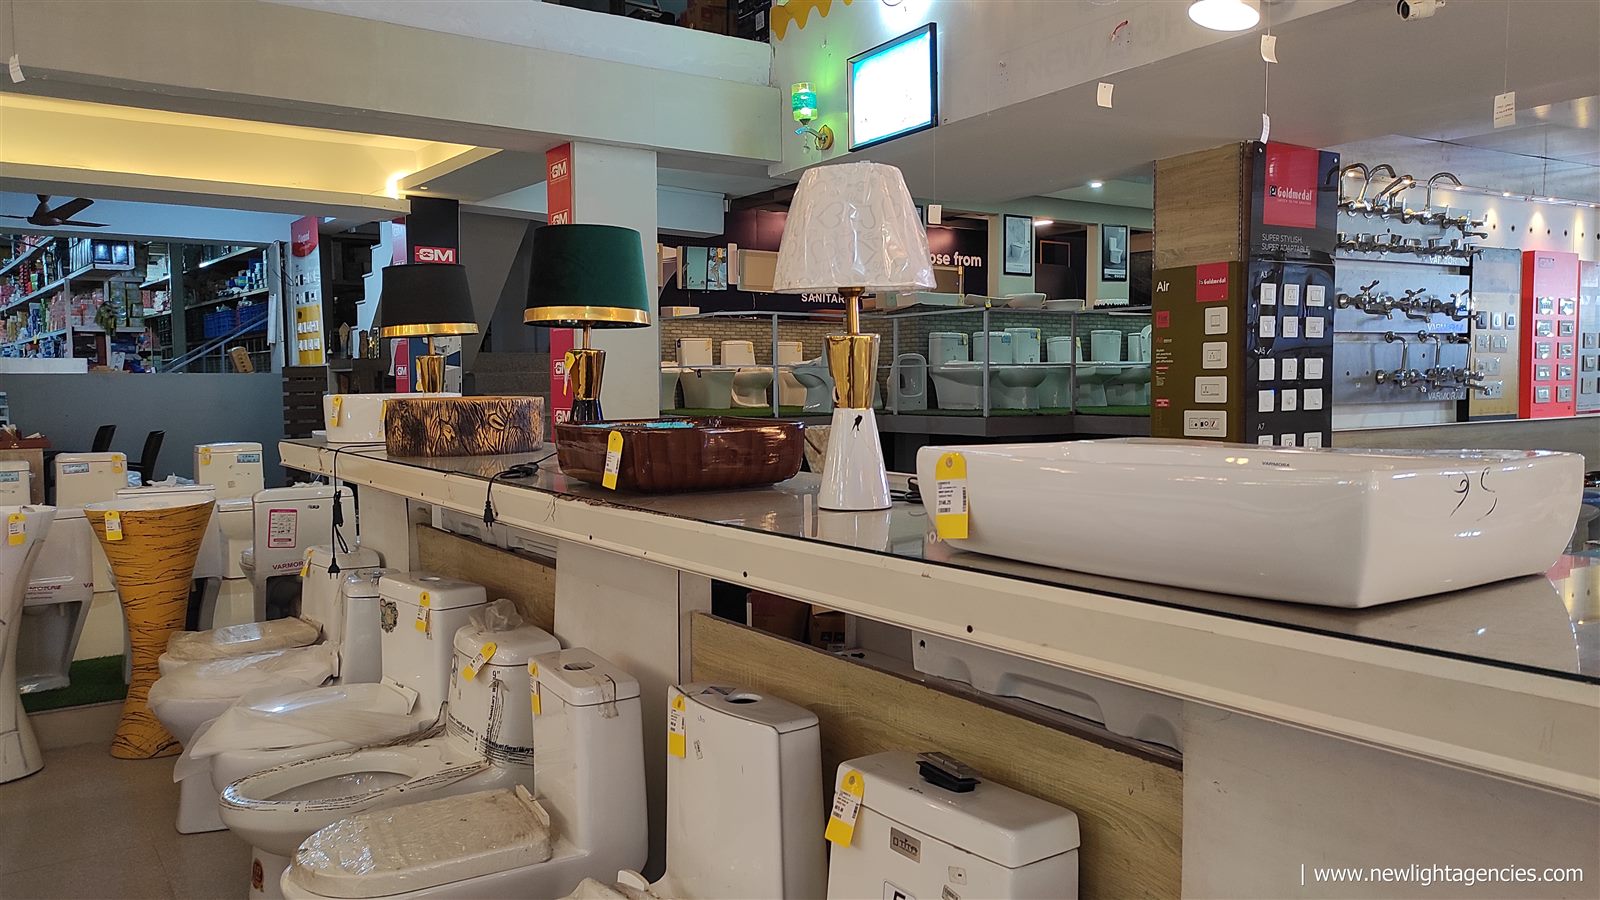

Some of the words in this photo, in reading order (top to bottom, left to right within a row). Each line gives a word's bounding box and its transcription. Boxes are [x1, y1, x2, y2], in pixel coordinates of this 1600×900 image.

[551, 161, 568, 179] GM
[1277, 186, 1312, 201] Goldmedal
[552, 212, 568, 225] GM
[1262, 233, 1280, 242] SUPER
[1261, 243, 1279, 251] SUPER
[418, 248, 453, 262] GM
[930, 253, 950, 265] ose
[953, 252, 982, 267] from
[1156, 280, 1170, 293] Air
